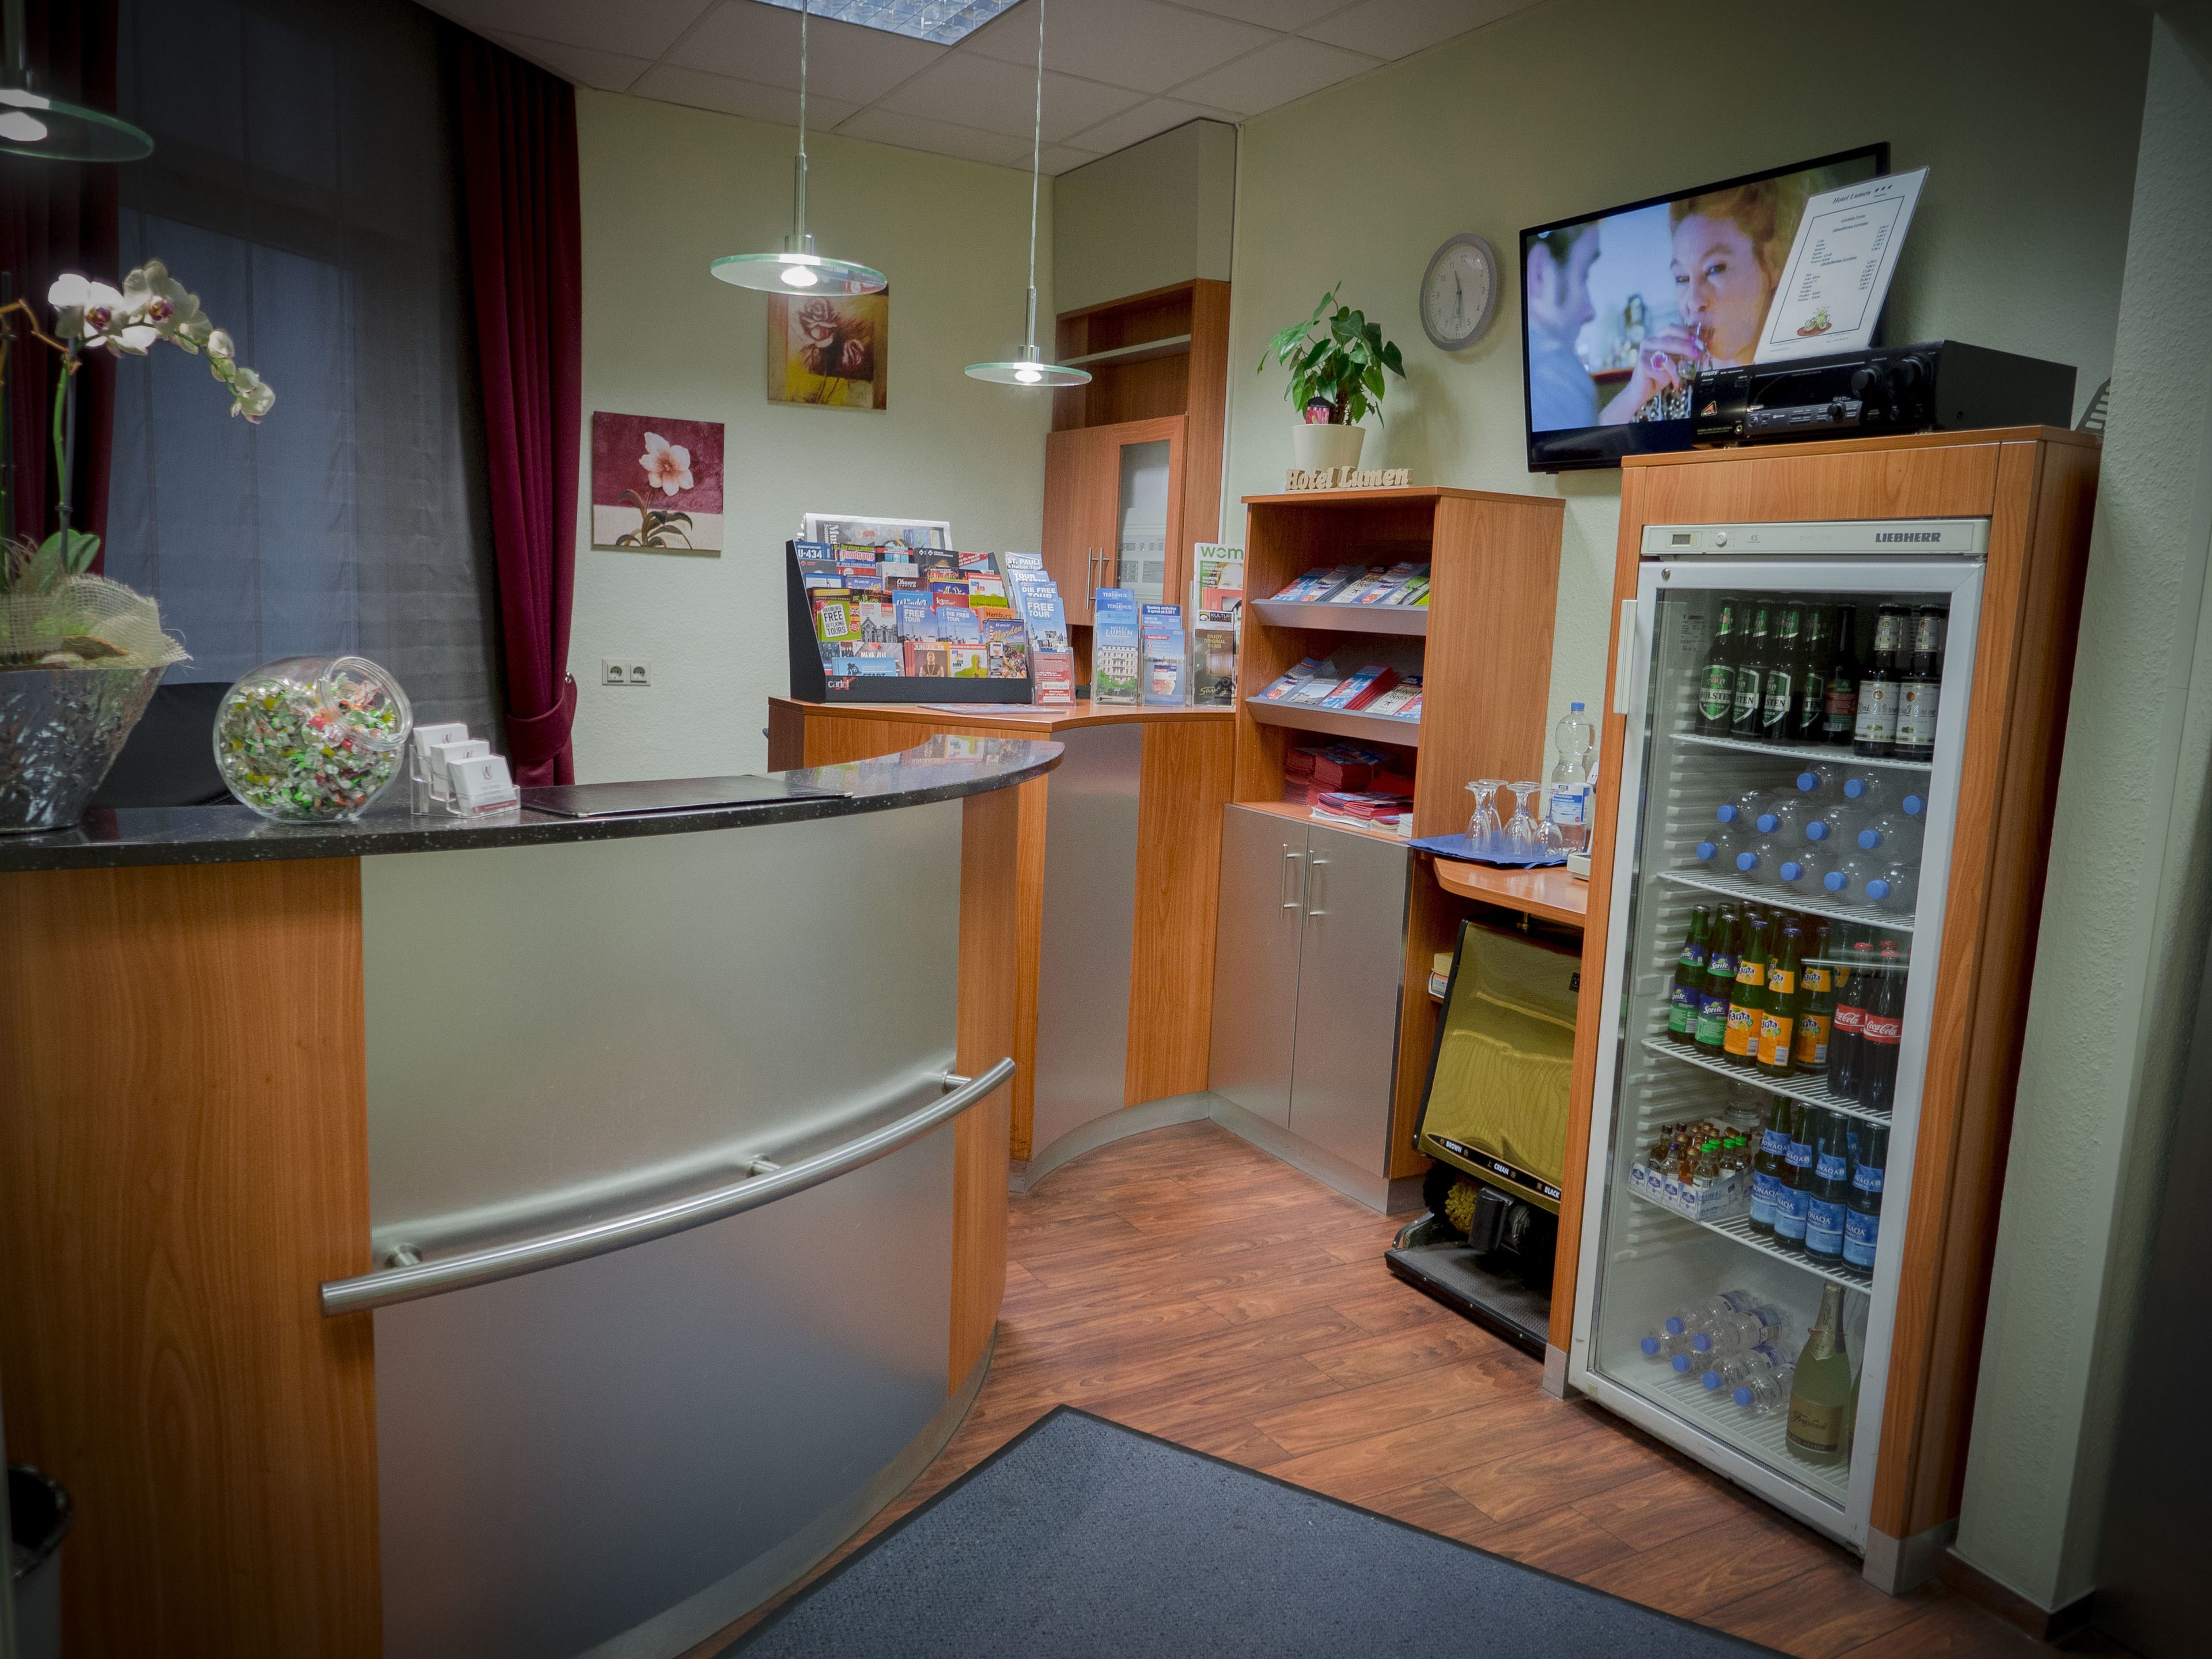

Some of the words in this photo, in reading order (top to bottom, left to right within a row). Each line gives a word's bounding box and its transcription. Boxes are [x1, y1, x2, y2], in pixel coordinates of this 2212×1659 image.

[1832, 196, 1850, 204] Hotel
[1850, 191, 1872, 199] Lumen
[1286, 467, 1338, 490] Hotel
[1339, 465, 1410, 488] Lumen
[1876, 532, 1941, 543] LIEBHERR
[842, 550, 874, 561] Rundgang
[904, 608, 925, 618] FREE
[1027, 603, 1054, 612] FREE
[824, 611, 843, 623] FREE
[986, 611, 1012, 619] Hamburg
[827, 627, 846, 635] TOURS
[1703, 1006, 1724, 1015] Sprite
[1446, 1141, 1462, 1153] BROWN
[1494, 1164, 1509, 1175] CREAM
[1544, 1187, 1560, 1199] BLACK
